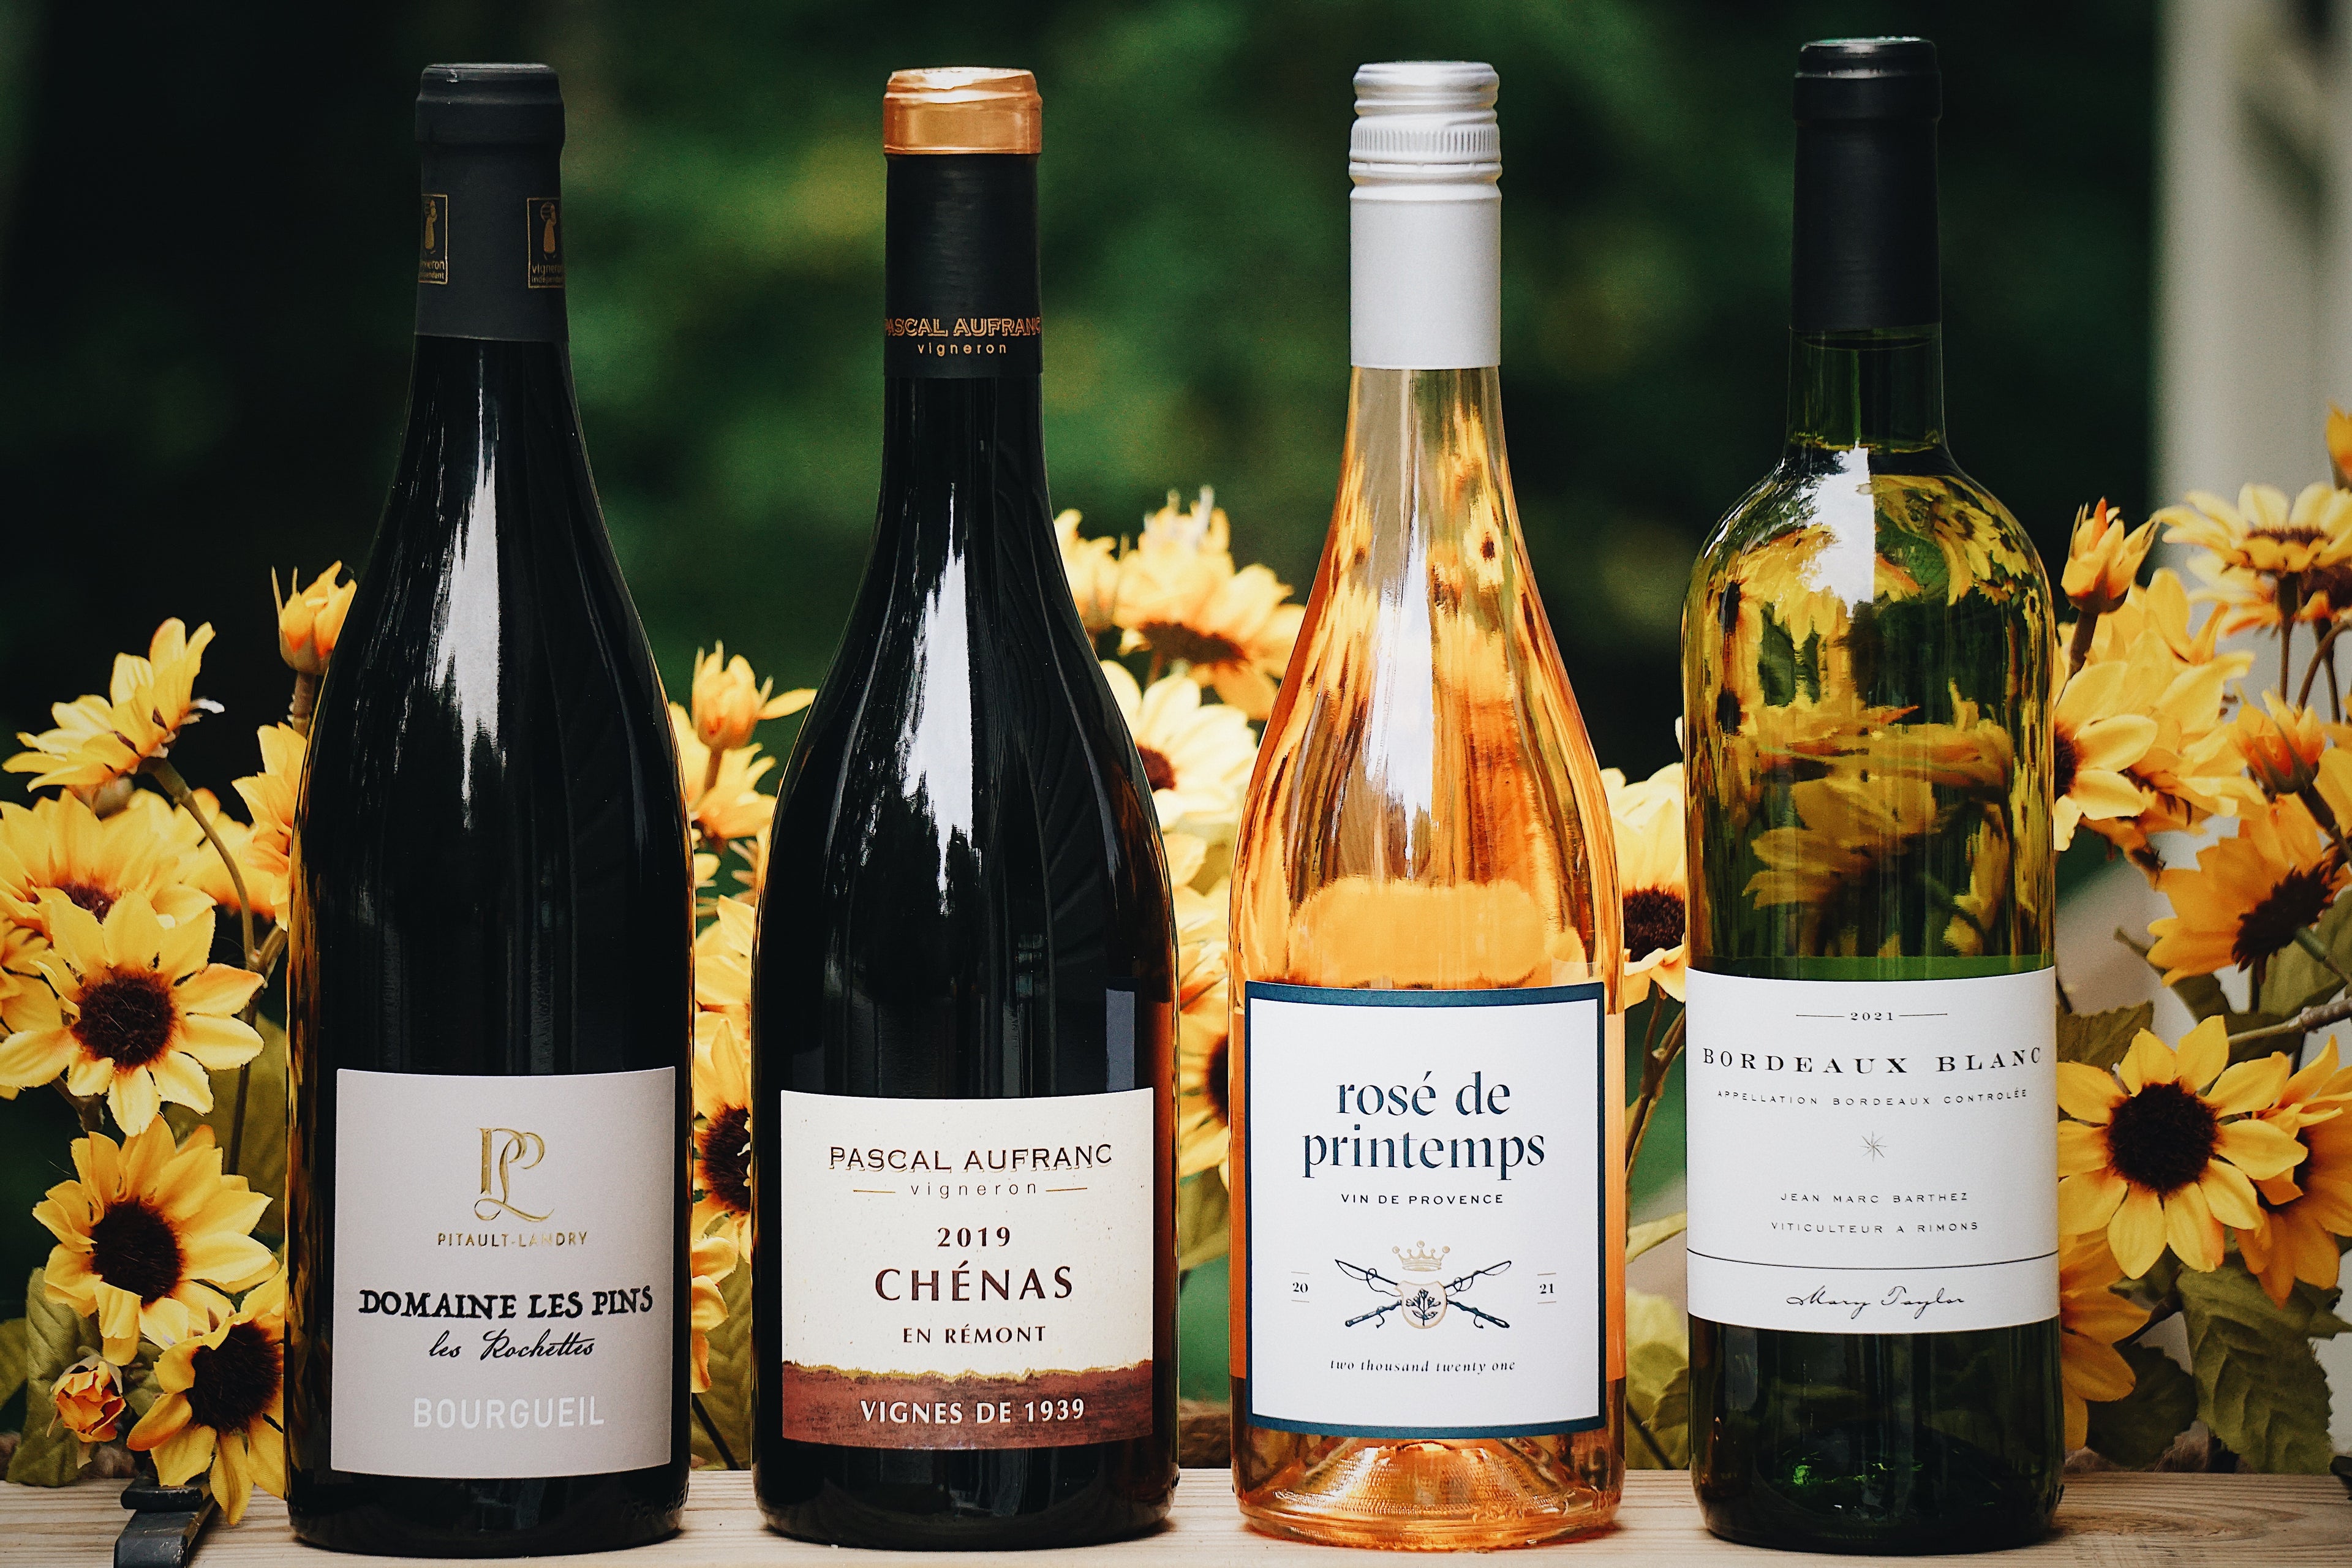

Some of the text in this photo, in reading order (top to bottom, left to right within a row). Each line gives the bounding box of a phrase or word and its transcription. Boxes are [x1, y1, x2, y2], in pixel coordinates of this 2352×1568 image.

[952, 317, 1041, 337] AUFRANC
[918, 342, 1006, 357] vigneron
[1850, 1012, 1893, 1022] 2021
[1702, 1046, 2041, 1074] BORDEAUX BLANC
[1336, 1070, 1511, 1117] rosé de
[1717, 1090, 1818, 1106] APPELLATION
[1832, 1096, 1931, 1106] BORDEAUX
[829, 1143, 1113, 1174] PASCAL AUFRANC
[1302, 1123, 1545, 1182] printemps
[911, 1182, 1036, 1200] vigneron
[1341, 1193, 1504, 1205] VIN DE PROVENCE
[1779, 1192, 1968, 1204] JEAN MARC BARTHEZ
[937, 1227, 1011, 1248] 2019
[1770, 1221, 1978, 1234] VITICULTEUR A RIMONS
[437, 1231, 589, 1248] PITAULT-LANDRY
[875, 1260, 1073, 1302] CHÉNAS
[1292, 1281, 1309, 1294] 20
[1539, 1282, 1555, 1295] 21
[358, 1285, 654, 1321] DOMAINE LES PINS
[1786, 1285, 1966, 1320] Mary Taylor
[903, 1324, 1047, 1344] EN RÉMONT
[428, 1328, 596, 1362] les Rochettes
[1330, 1359, 1516, 1376] two thousand twenty one
[413, 1396, 605, 1429] BOURGUEIL
[861, 1398, 1085, 1425] VIGNES DE 1939
